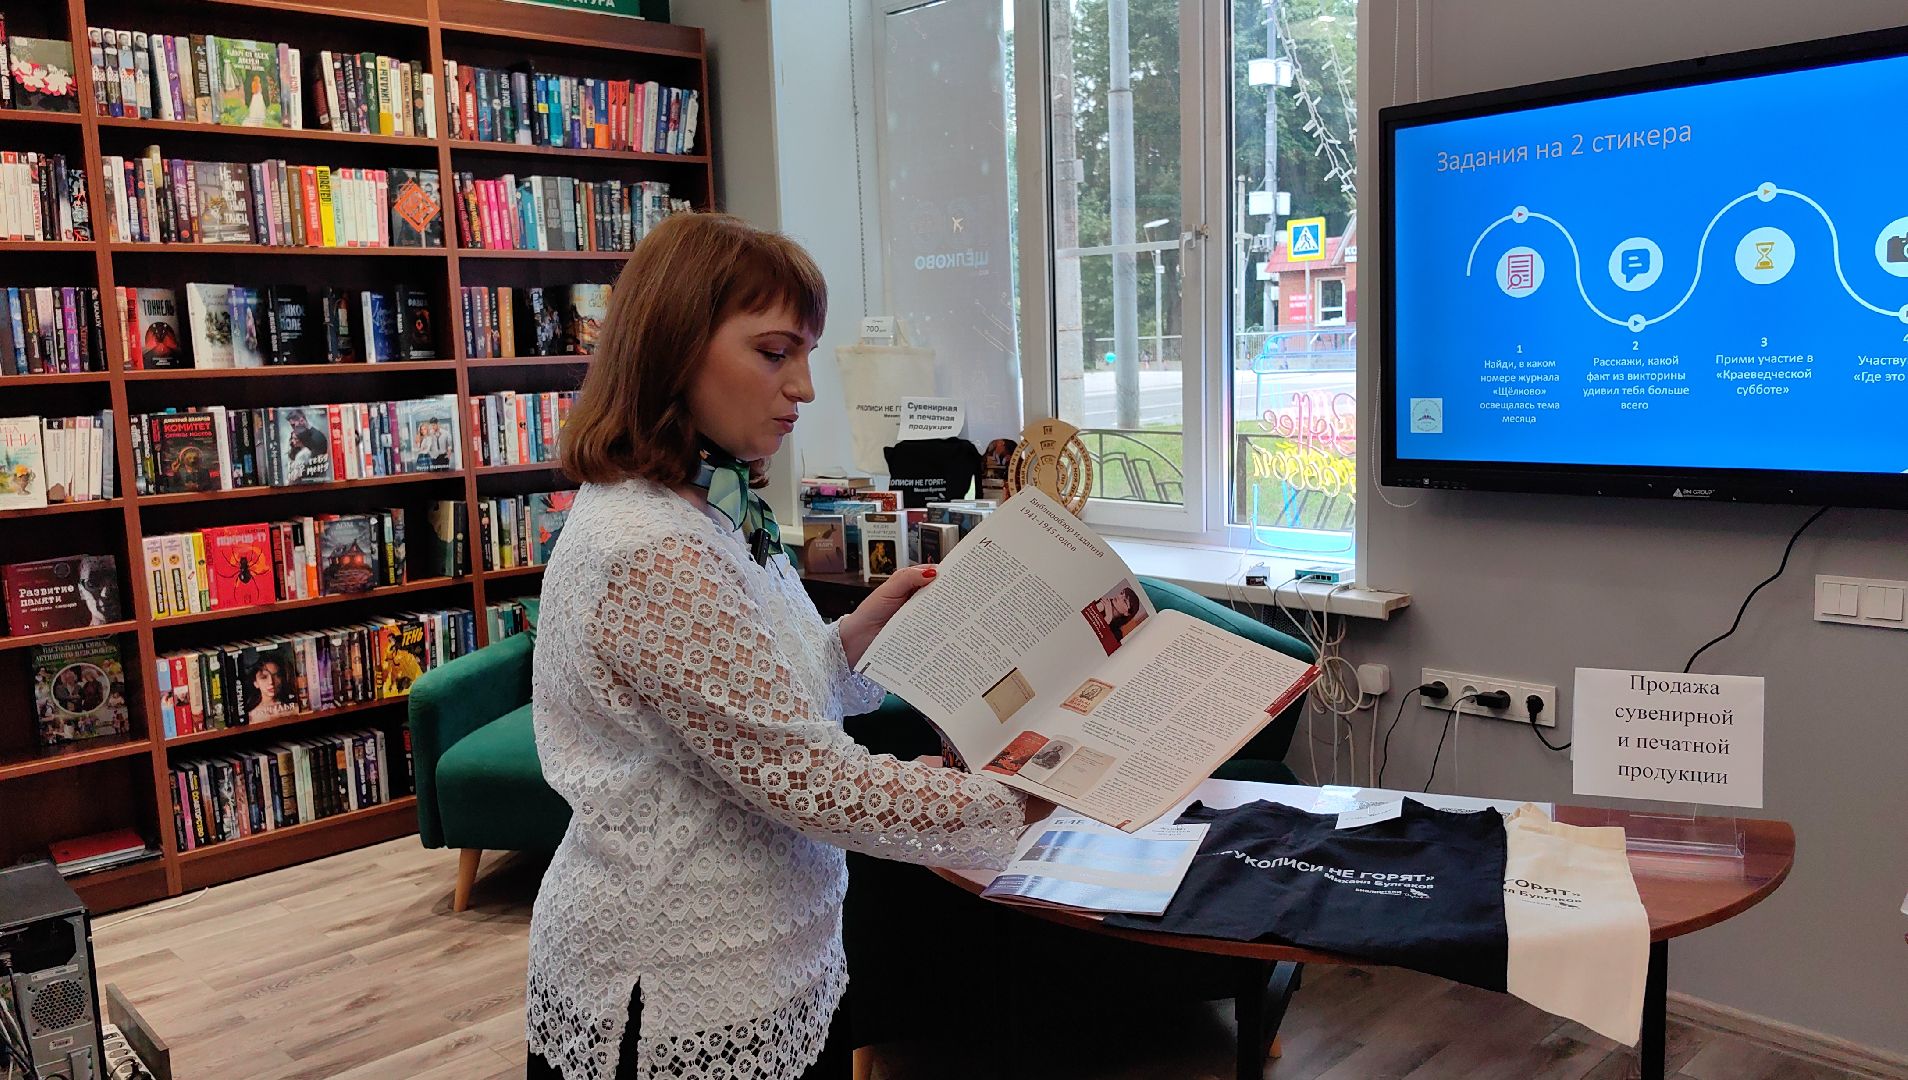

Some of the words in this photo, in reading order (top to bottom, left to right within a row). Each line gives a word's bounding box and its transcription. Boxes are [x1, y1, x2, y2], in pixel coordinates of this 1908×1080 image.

[1437, 146, 1528, 173] Задания
[1536, 141, 1563, 160] на
[1571, 134, 1584, 156] 2
[1592, 124, 1692, 153] стикера
[1632, 341, 1639, 350] 2
[1760, 337, 1768, 348] 3
[1516, 345, 1523, 354] 1
[1484, 359, 1517, 370] Найди,
[1526, 360, 1556, 368] каком
[1593, 357, 1645, 368] Расскажи,
[1647, 355, 1679, 366] какой
[1715, 354, 1755, 366] Прими
[1758, 354, 1804, 365] участие
[1806, 354, 1814, 363] в
[1480, 374, 1516, 384] номере
[1518, 374, 1560, 384] журнала
[1586, 371, 1610, 384] факт
[1612, 373, 1625, 381] из
[1627, 372, 1686, 382] викторины
[1716, 368, 1812, 382] «Краеведческой
[1853, 372, 1882, 382] «Где
[1885, 373, 1905, 382] это
[1493, 386, 1547, 398] «Щёлково»
[1582, 386, 1620, 398] удивил
[1621, 386, 1645, 395] тебя
[1647, 385, 1690, 395] больше
[1736, 384, 1790, 397] субботе»
[907, 402, 958, 412] Сувенирная
[1480, 401, 1535, 410] освещалась
[1536, 401, 1560, 410] тема
[1620, 401, 1648, 410] всего
[916, 414, 955, 422] печатная
[1502, 415, 1537, 425] месяца
[163, 422, 211, 432] КОМИТЕТ
[890, 479, 914, 487] ОПИСИ
[1030, 498, 1075, 533] Библиообзор
[1074, 531, 1104, 558] изданий
[1055, 533, 1077, 552] годов
[19, 585, 75, 598] Развитие
[20, 595, 62, 608] памяти
[1630, 674, 1721, 696] Продажа
[1614, 706, 1734, 727] сувенирной
[1617, 736, 1629, 747] и
[1636, 736, 1730, 755] печатной
[1617, 764, 1729, 785] продукции
[1212, 849, 1324, 873] УКОПИСИ
[1328, 867, 1355, 878] НЕ
[1359, 872, 1435, 882] ГОРЯТ»
[1324, 872, 1371, 885] Михаил
[1374, 880, 1434, 890] Булгаков
[1519, 890, 1582, 903] Булгаков
